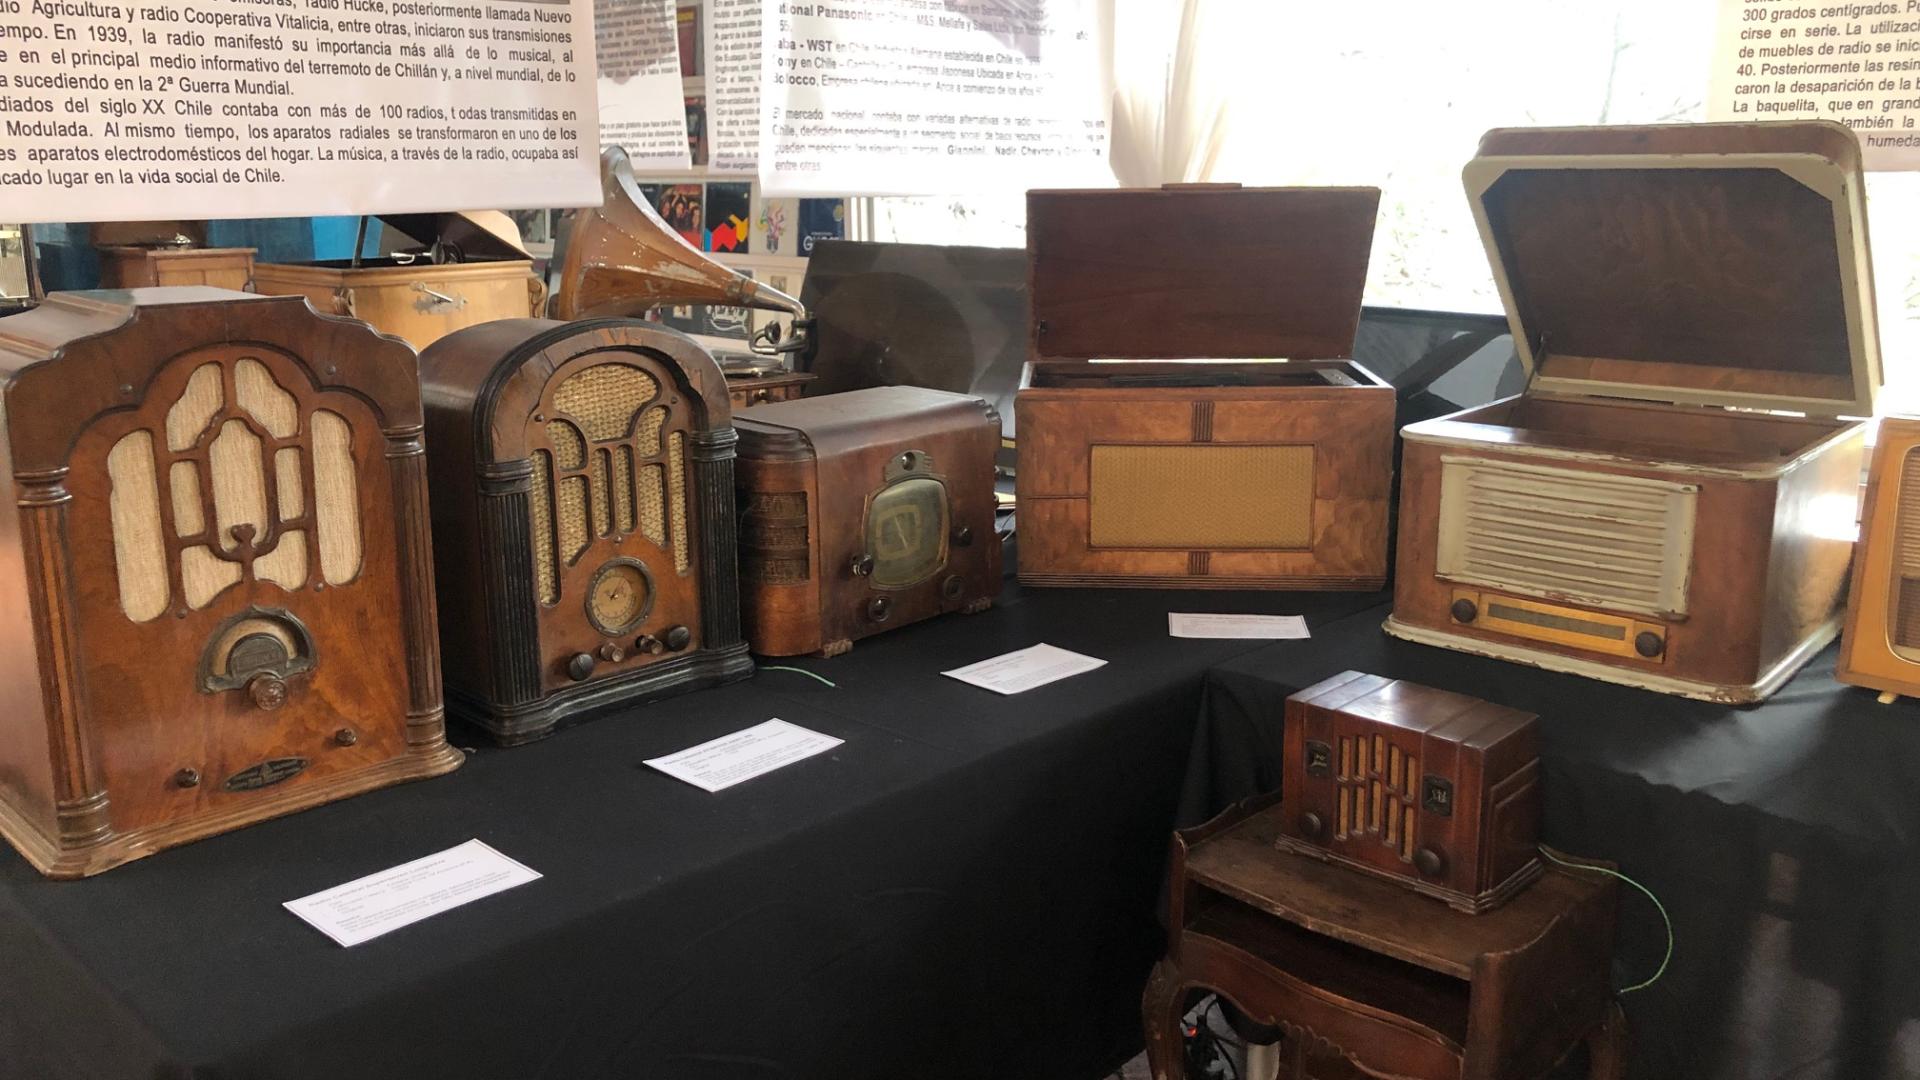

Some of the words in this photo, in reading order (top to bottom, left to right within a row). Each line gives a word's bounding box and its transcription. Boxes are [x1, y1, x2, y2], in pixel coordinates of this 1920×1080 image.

[32, 0, 121, 19] Agricultura
[127, 8, 134, 23] y
[141, 6, 179, 22] radio
[184, 7, 272, 28] Cooperativa
[275, 13, 333, 33] Vitalicia,
[338, 19, 371, 33] entre
[375, 21, 411, 37] otras,
[414, 22, 465, 38] iniciaron
[469, 28, 489, 40] sus
[492, 27, 572, 43] transmisiones
[393, 2, 482, 19] posteriormente
[486, 6, 531, 21] llamada
[534, 9, 572, 23] Nuevo
[1743, 8, 1767, 21] 300
[1771, 6, 1816, 23] grados
[1741, 27, 1771, 40] cirse
[1780, 28, 1796, 38] en
[1805, 24, 1840, 37] serie.
[1846, 23, 1861, 35] La
[0, 25, 48, 42] empo.
[54, 24, 76, 40] En
[88, 26, 132, 45] 1939,
[143, 28, 156, 44] la
[167, 31, 204, 46] radio
[214, 34, 283, 50] manifestó
[292, 40, 308, 52] su
[316, 38, 391, 56] importancia
[400, 43, 426, 57] más
[434, 44, 454, 58] allá
[466, 46, 480, 59] de
[487, 46, 498, 60] lo
[509, 48, 555, 64] musical,
[563, 50, 573, 62] al
[807, 40, 832, 52] WST
[1739, 46, 1754, 58] de
[1759, 44, 1813, 57] muebles
[1818, 42, 1834, 55] de
[1839, 41, 1871, 54] radio
[1876, 43, 1891, 53] se
[0, 50, 7, 62] e
[19, 51, 40, 63] en
[51, 48, 66, 64] el
[71, 50, 139, 70] principal
[150, 53, 196, 69] medio
[201, 55, 279, 72] informativo
[284, 59, 304, 73] del
[308, 61, 371, 76] terremoto
[375, 62, 391, 76] de
[395, 63, 437, 78] Chillán
[441, 69, 451, 81] y,
[455, 69, 462, 79] a
[466, 66, 492, 80] nivel
[496, 68, 543, 83] mundial,
[547, 69, 561, 82] de
[565, 69, 576, 82] lo
[801, 59, 812, 68] en
[814, 57, 836, 69] Chile
[1737, 64, 1756, 76] 40.
[1761, 61, 1860, 75] Posteriormente
[1864, 60, 1883, 72] las
[0, 75, 8, 87] a
[14, 73, 109, 90] sucediendo
[114, 78, 134, 90] en
[139, 75, 153, 91] la
[158, 76, 173, 91] 2ª
[179, 77, 230, 93] Guerra
[235, 79, 294, 95] Mundial.
[1735, 84, 1770, 94] caron
[1774, 81, 1785, 93] la
[1790, 79, 1874, 95] desaparición
[1878, 78, 1895, 91] de
[1899, 77, 1911, 90] la
[0, 96, 53, 112] diados
[65, 97, 89, 113] del
[100, 98, 136, 117] siglo
[142, 99, 165, 114] XX
[175, 100, 212, 115] Chile
[222, 102, 278, 116] contaba
[288, 106, 311, 117] con
[320, 104, 347, 118] más
[355, 104, 371, 118] de
[380, 104, 402, 118] 100
[407, 105, 447, 121] radios,
[459, 106, 487, 120] odas
[490, 107, 558, 120] transmitidas
[562, 111, 576, 120] en
[786, 109, 823, 120] mercado
[1733, 101, 1748, 112] La
[1757, 99, 1818, 114] baquelita,
[1828, 101, 1852, 113] que
[1857, 100, 1873, 110] en
[1903, 115, 1914, 128] la
[6, 120, 93, 137] Modulada.
[105, 122, 119, 137] Al
[125, 123, 175, 138] mismo
[185, 123, 239, 142] tiempo,
[248, 124, 269, 139] los
[273, 126, 331, 142] aparatos
[340, 125, 390, 139] radiales
[398, 129, 412, 139] se
[416, 126, 498, 140] transformaron
[502, 130, 516, 140] en
[519, 130, 539, 140] uno
[543, 127, 556, 140] de
[560, 127, 576, 140] los
[0, 149, 16, 161] es
[28, 146, 99, 165] aparatos
[105, 145, 241, 161] electrodomésticos
[246, 146, 267, 161] del
[271, 146, 313, 164] hogar.
[318, 146, 334, 160] La
[338, 146, 387, 162] música,
[391, 150, 398, 160] a
[402, 147, 440, 160] través
[444, 147, 458, 160] de
[462, 146, 472, 160] la
[476, 146, 508, 161] radio,
[512, 147, 559, 162] ocupaba
[562, 146, 578, 159] así
[0, 169, 42, 185] cado
[47, 169, 89, 188] lugar
[95, 173, 114, 184] en
[119, 169, 134, 184] la
[138, 169, 170, 183] vida
[175, 168, 218, 183] social
[223, 169, 240, 183] de
[245, 168, 284, 183] Chile.
